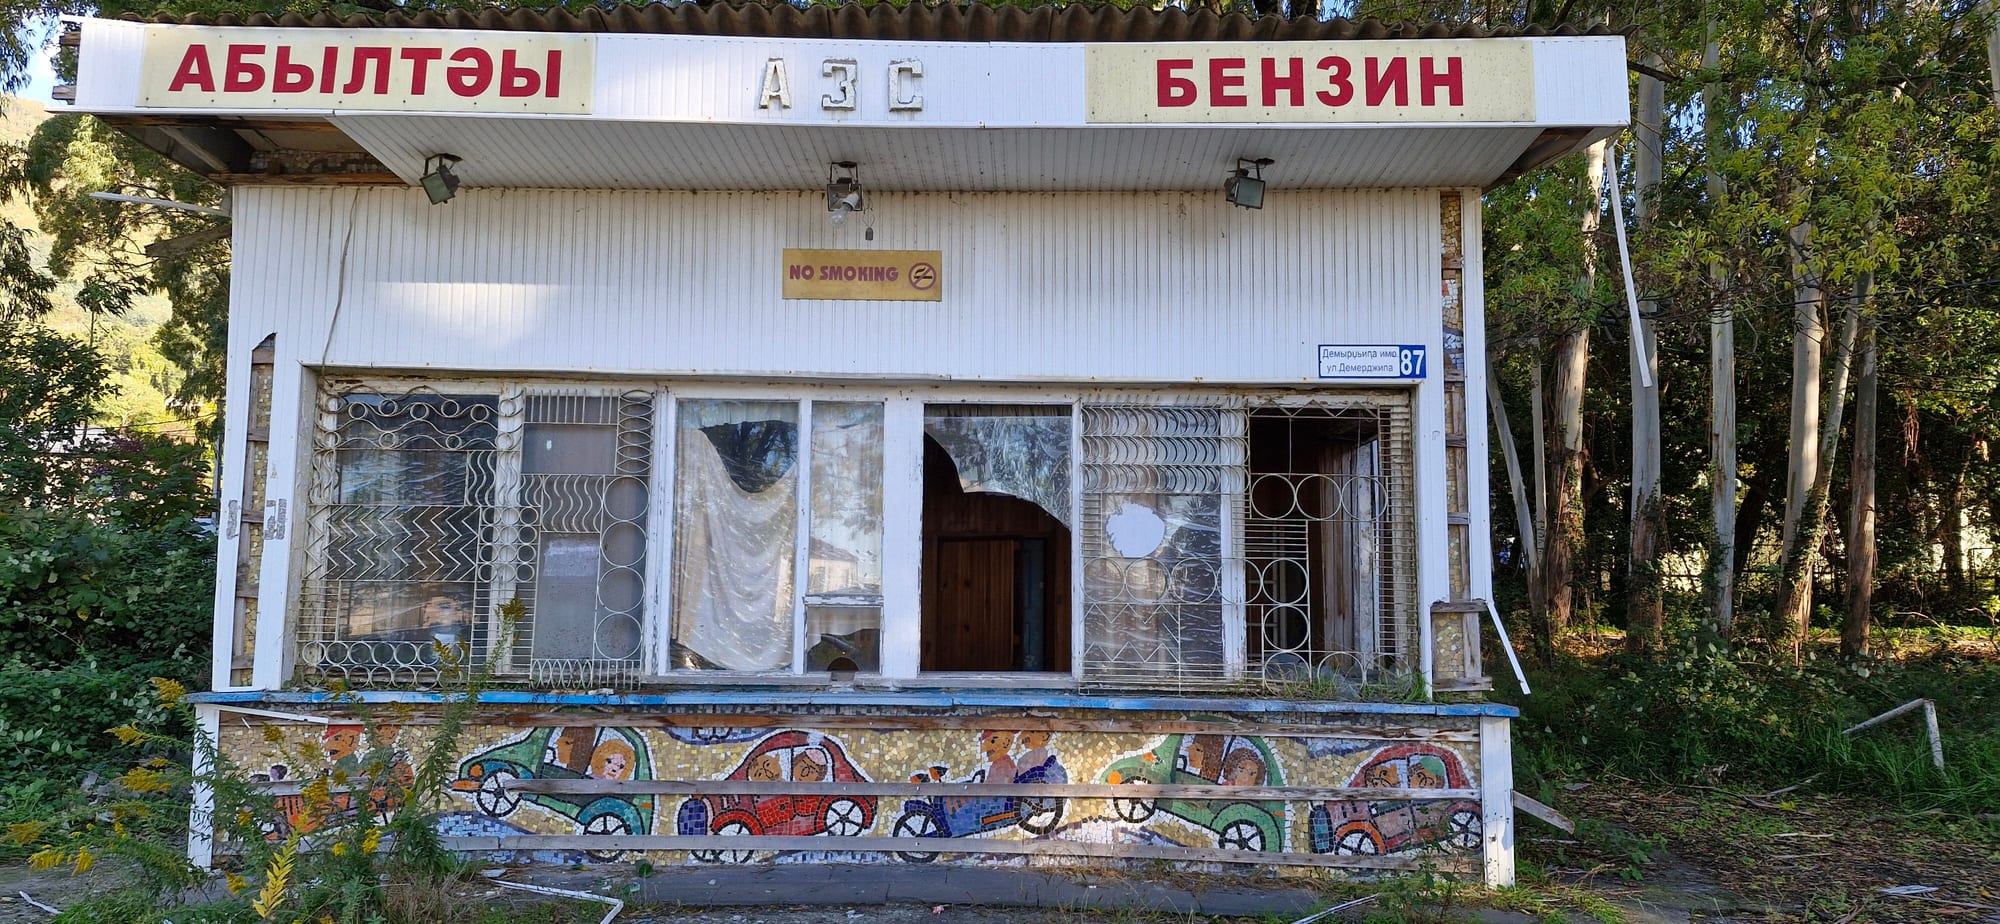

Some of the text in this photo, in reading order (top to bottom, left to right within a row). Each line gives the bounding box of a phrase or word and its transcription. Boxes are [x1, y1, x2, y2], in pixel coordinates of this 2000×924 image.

[168, 44, 562, 98] АБЫЛТӘЫ
[1156, 56, 1464, 107] БЕНЗИН
[789, 265, 899, 281] NO SMOKING
[1401, 350, 1424, 375] 87
